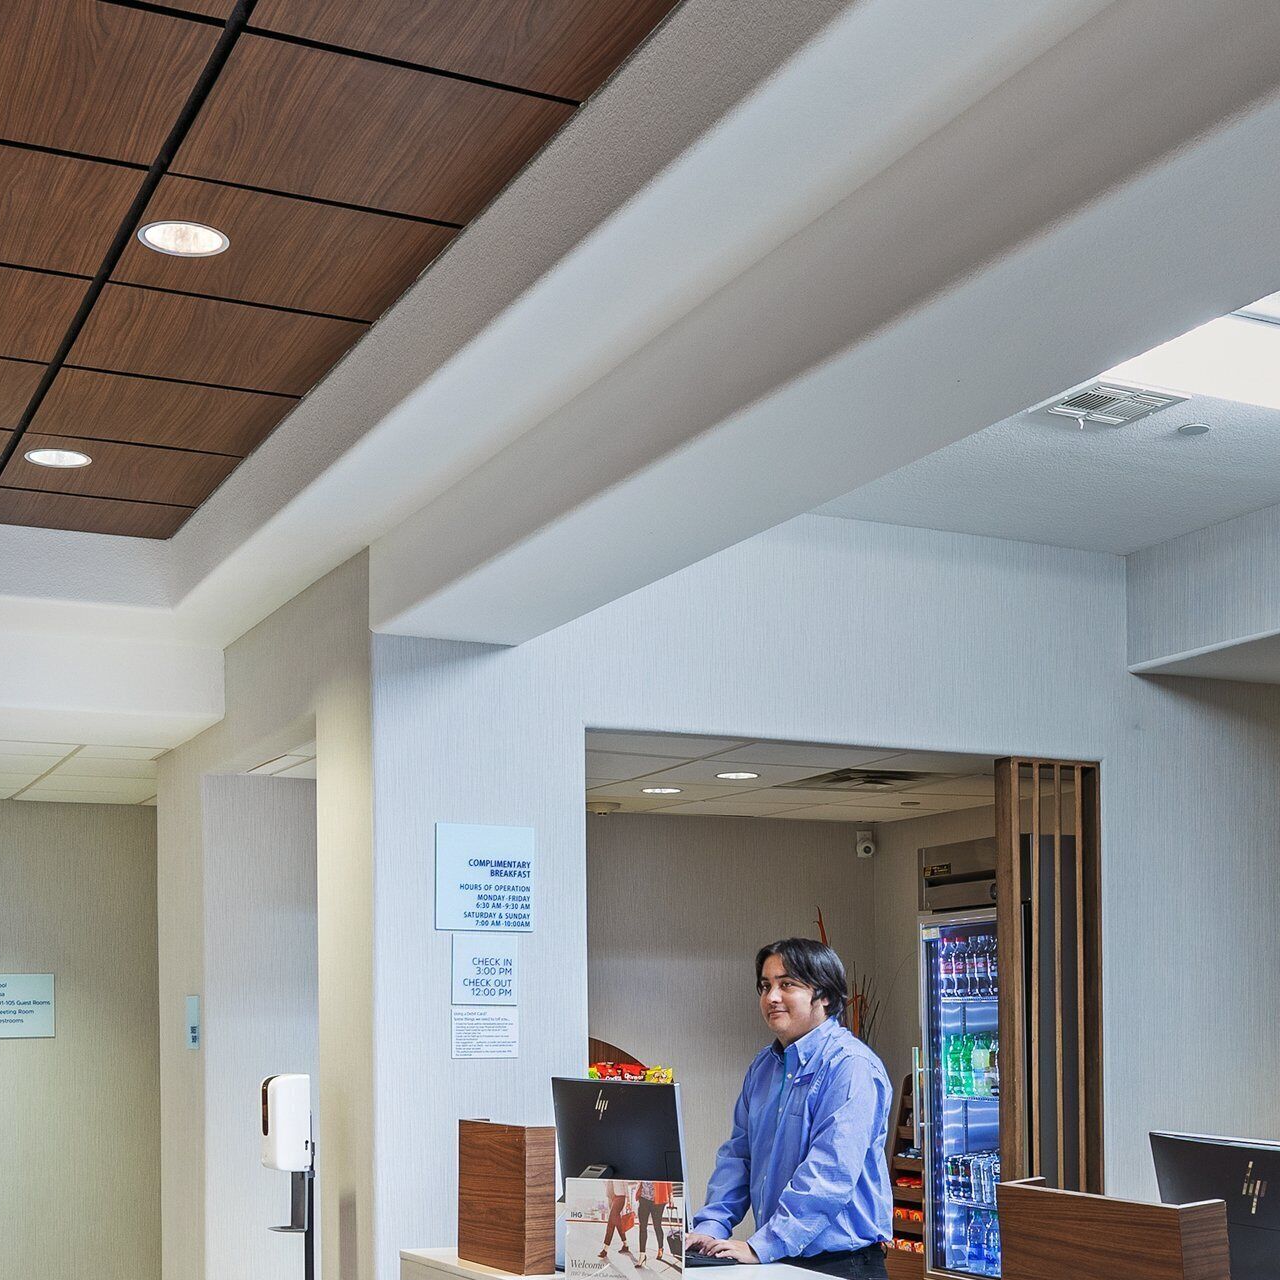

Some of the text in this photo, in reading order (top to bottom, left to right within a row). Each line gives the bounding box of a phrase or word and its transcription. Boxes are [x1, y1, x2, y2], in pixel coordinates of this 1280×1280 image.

[468, 858, 531, 869] COMPLIMENTARY
[490, 869, 531, 878] BREAKFAST
[459, 883, 482, 891] HOURS
[494, 884, 531, 893] OPERATION
[476, 901, 490, 909] 6:30
[463, 911, 497, 919] SATURDAY
[505, 912, 531, 920] SUNDAY
[475, 919, 489, 927] 7:00
[472, 957, 513, 967] CHECK IN
[476, 966, 513, 976] 3:00 PM
[463, 978, 512, 988] CHECK OUT
[471, 987, 512, 997] 12:00 PM
[570, 1211, 583, 1219] IHG
[570, 1259, 605, 1270] Welcome
